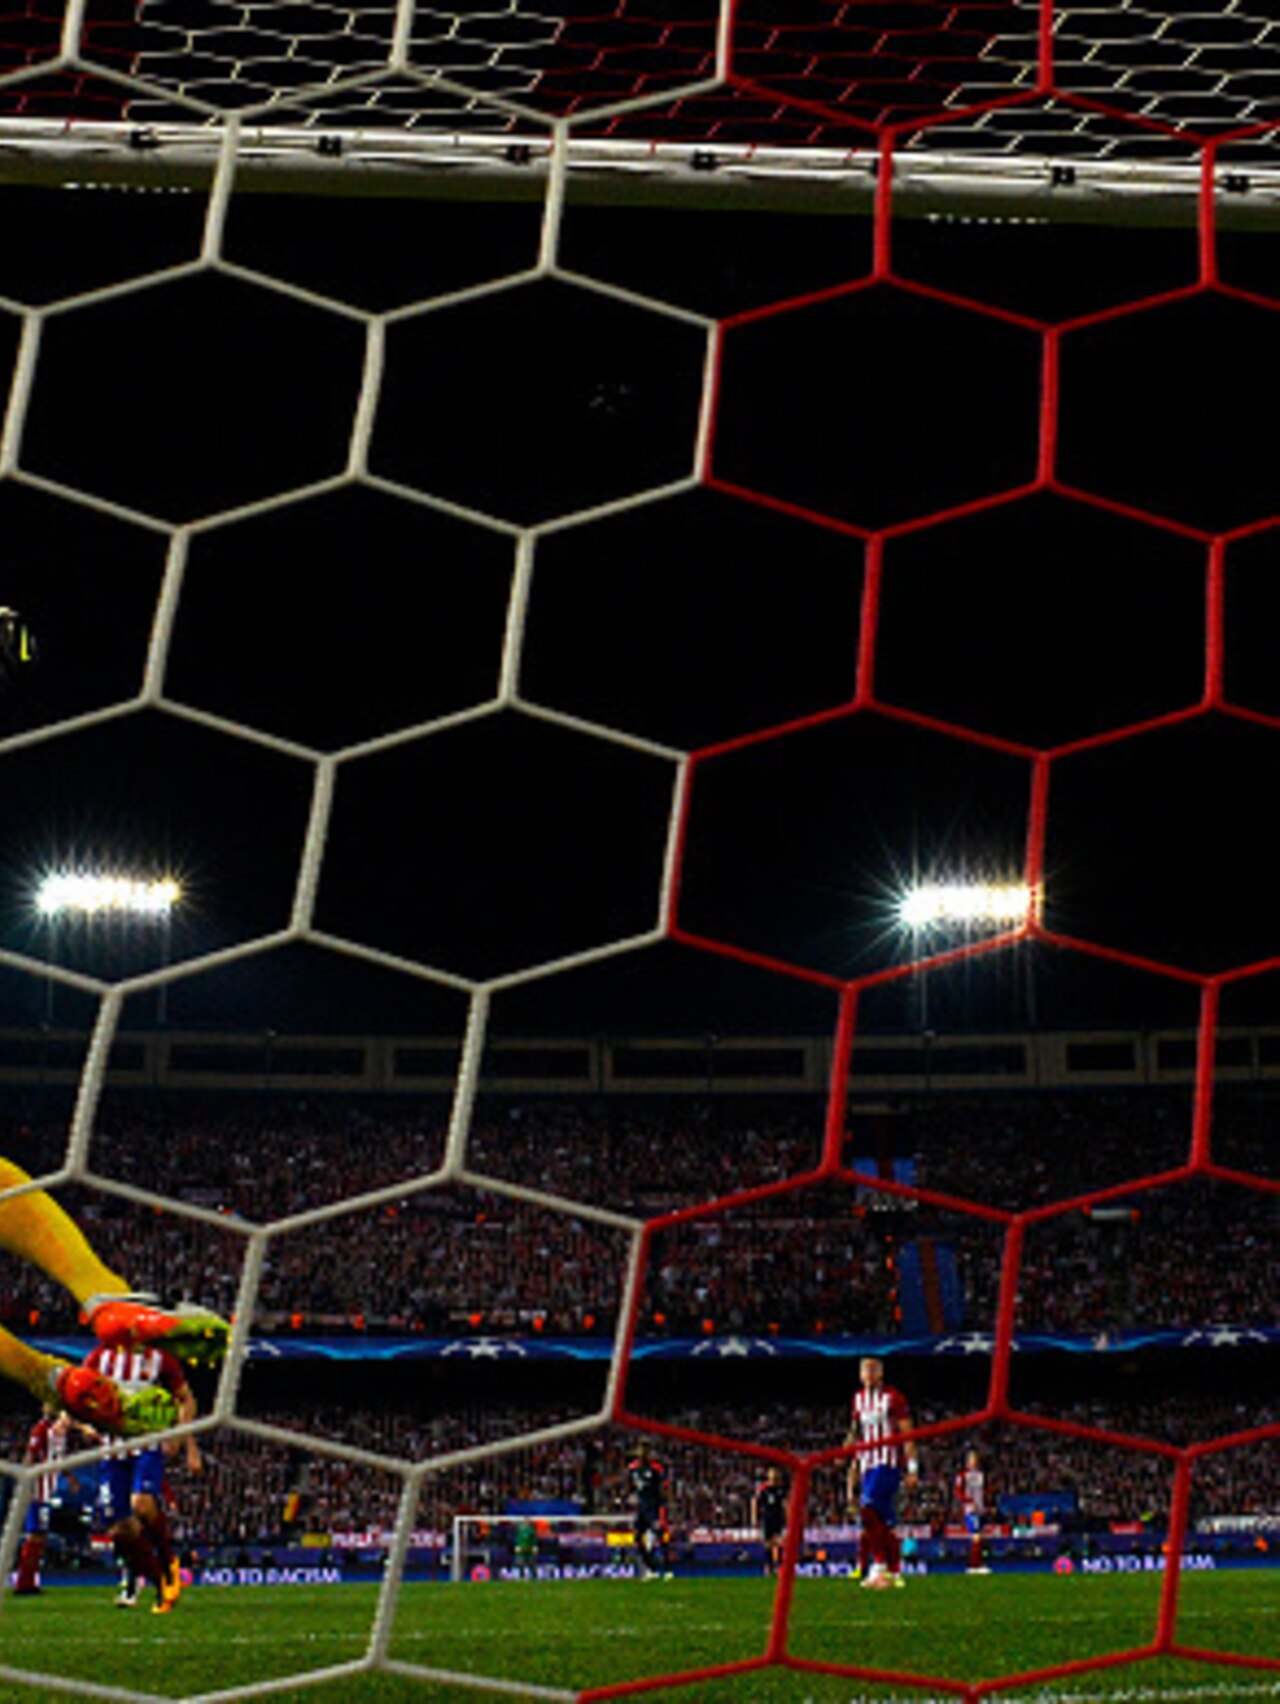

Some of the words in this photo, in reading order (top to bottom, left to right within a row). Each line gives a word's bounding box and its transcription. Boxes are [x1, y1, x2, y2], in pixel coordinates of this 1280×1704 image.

[1082, 1557, 1112, 1574] NO
[1116, 1556, 1141, 1573] TO
[201, 1568, 234, 1585] NO
[237, 1567, 263, 1585] TO
[266, 1567, 340, 1584] RACISM
